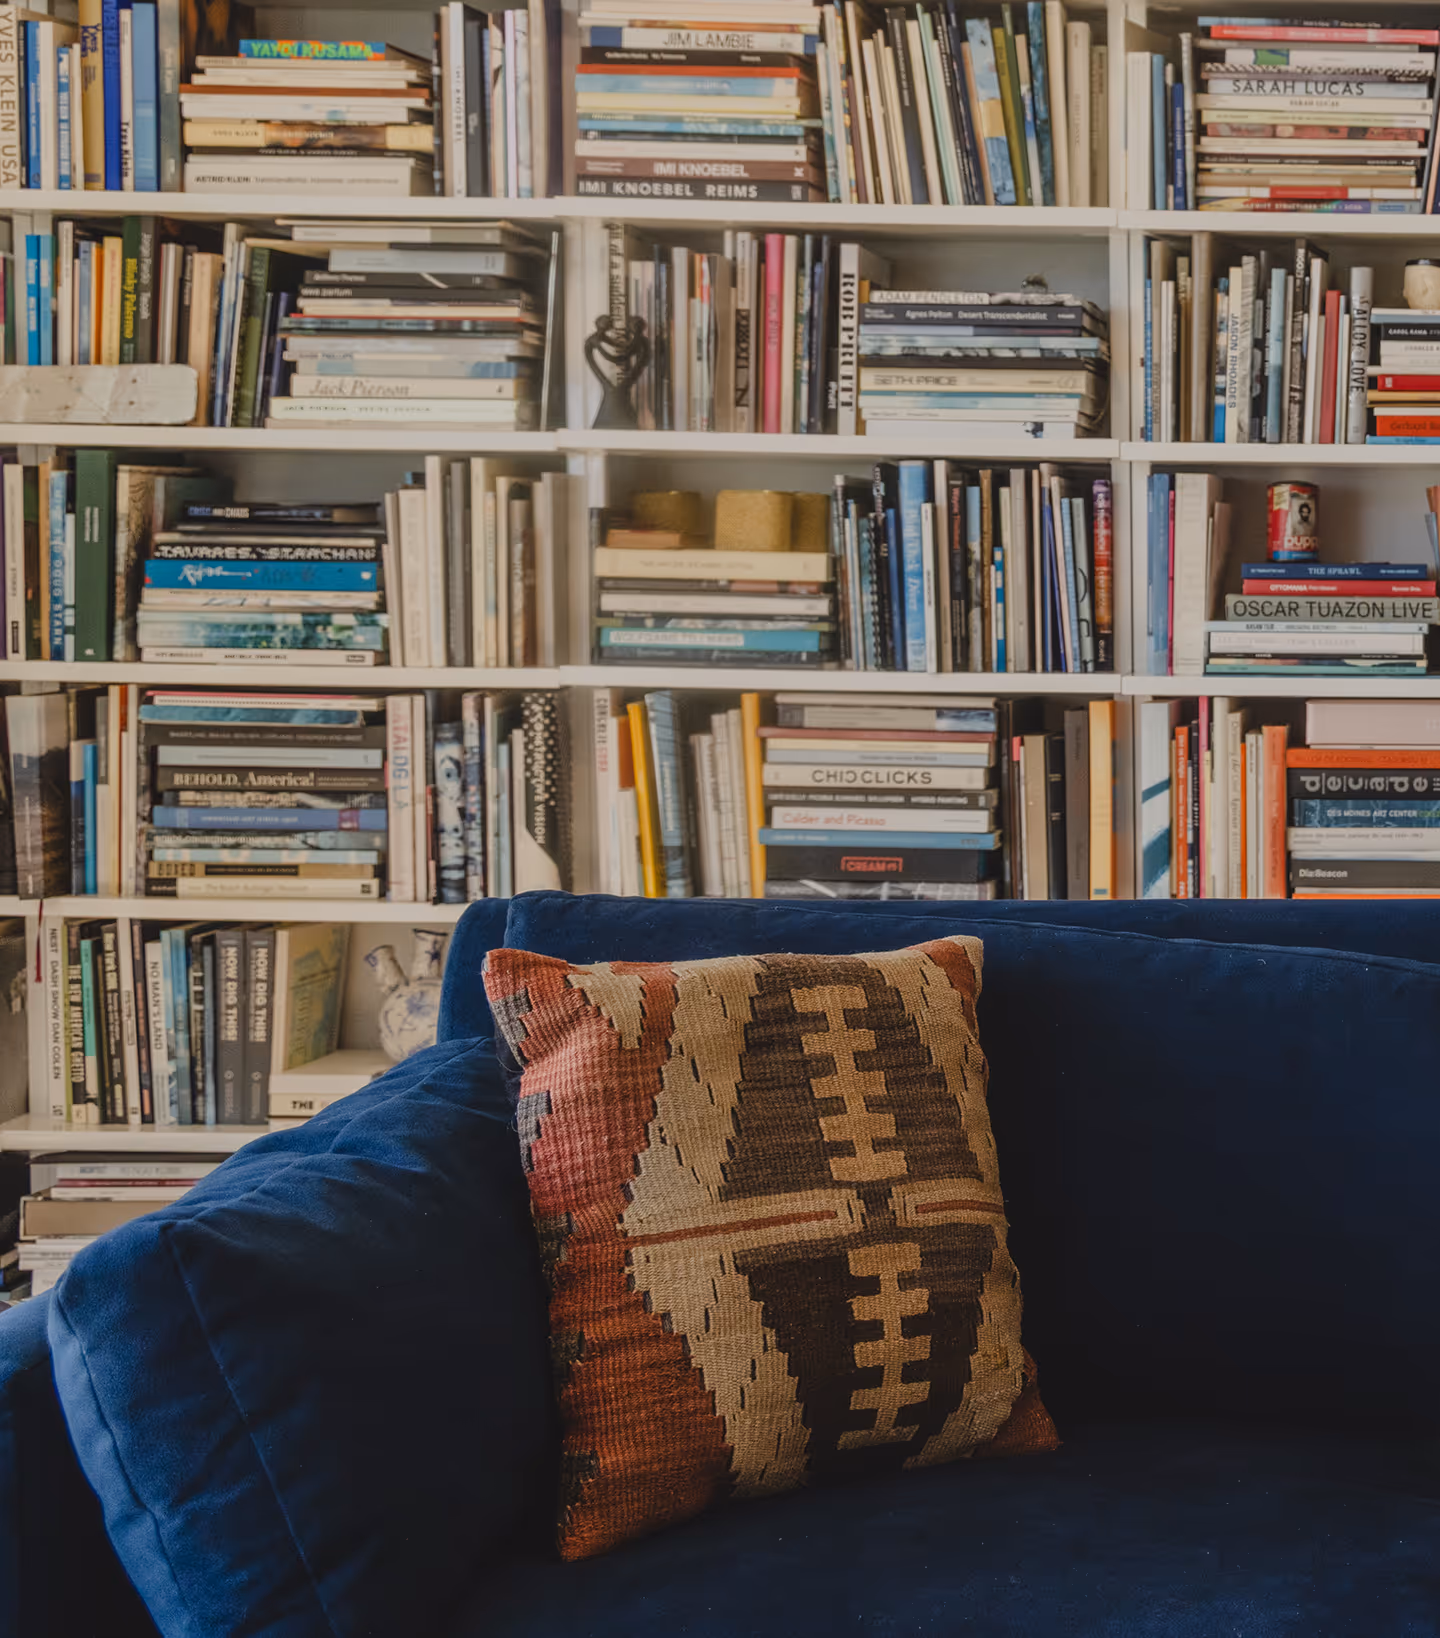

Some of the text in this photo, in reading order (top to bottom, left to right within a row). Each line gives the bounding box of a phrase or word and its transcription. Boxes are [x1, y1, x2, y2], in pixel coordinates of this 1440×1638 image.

[89, 23, 101, 54] Yves
[663, 32, 754, 48] JIM LAMBIE
[251, 41, 374, 59] YAYOI KUSAMA
[0, 9, 18, 184] YVES KLEIN USA
[1232, 79, 1365, 95] SARAH LUCAS
[653, 162, 748, 177] IMI KNOEBEL
[578, 180, 758, 198] IMI KNOEBEL REIMS
[123, 257, 138, 338] Blinky Palermo
[842, 273, 855, 320] ROB
[917, 292, 984, 304] PENDLETON
[905, 310, 927, 320] Agnes
[1350, 307, 1367, 393] ALLOY LOVE
[1228, 313, 1239, 408] JASON RHOADES
[308, 379, 409, 396] Jack Pierson
[873, 375, 957, 386] SETH PRICE
[1390, 421, 1427, 431] Gerhard
[53, 559, 64, 597] DOUG
[1307, 567, 1362, 575] THE SPRAWL
[1232, 599, 1434, 619] OSCAR TUAZON LIVE
[53, 603, 64, 645] STARN
[244, 771, 315, 787] America!
[860, 770, 933, 785] CLICKS
[782, 813, 886, 825] Calder and Picasso
[1326, 809, 1417, 818] DES MOINES ART CENTER
[534, 804, 546, 844] VISION
[225, 946, 239, 1042] NOW DIG THIS!
[255, 947, 268, 1043] NOW DIG THIS!
[49, 928, 62, 1080] NEST DASH SNOW DAN COLEN
[150, 960, 164, 1051] NO MAN'S LAND
[67, 964, 85, 1083] THE NEW AMERICAN GHETTO
